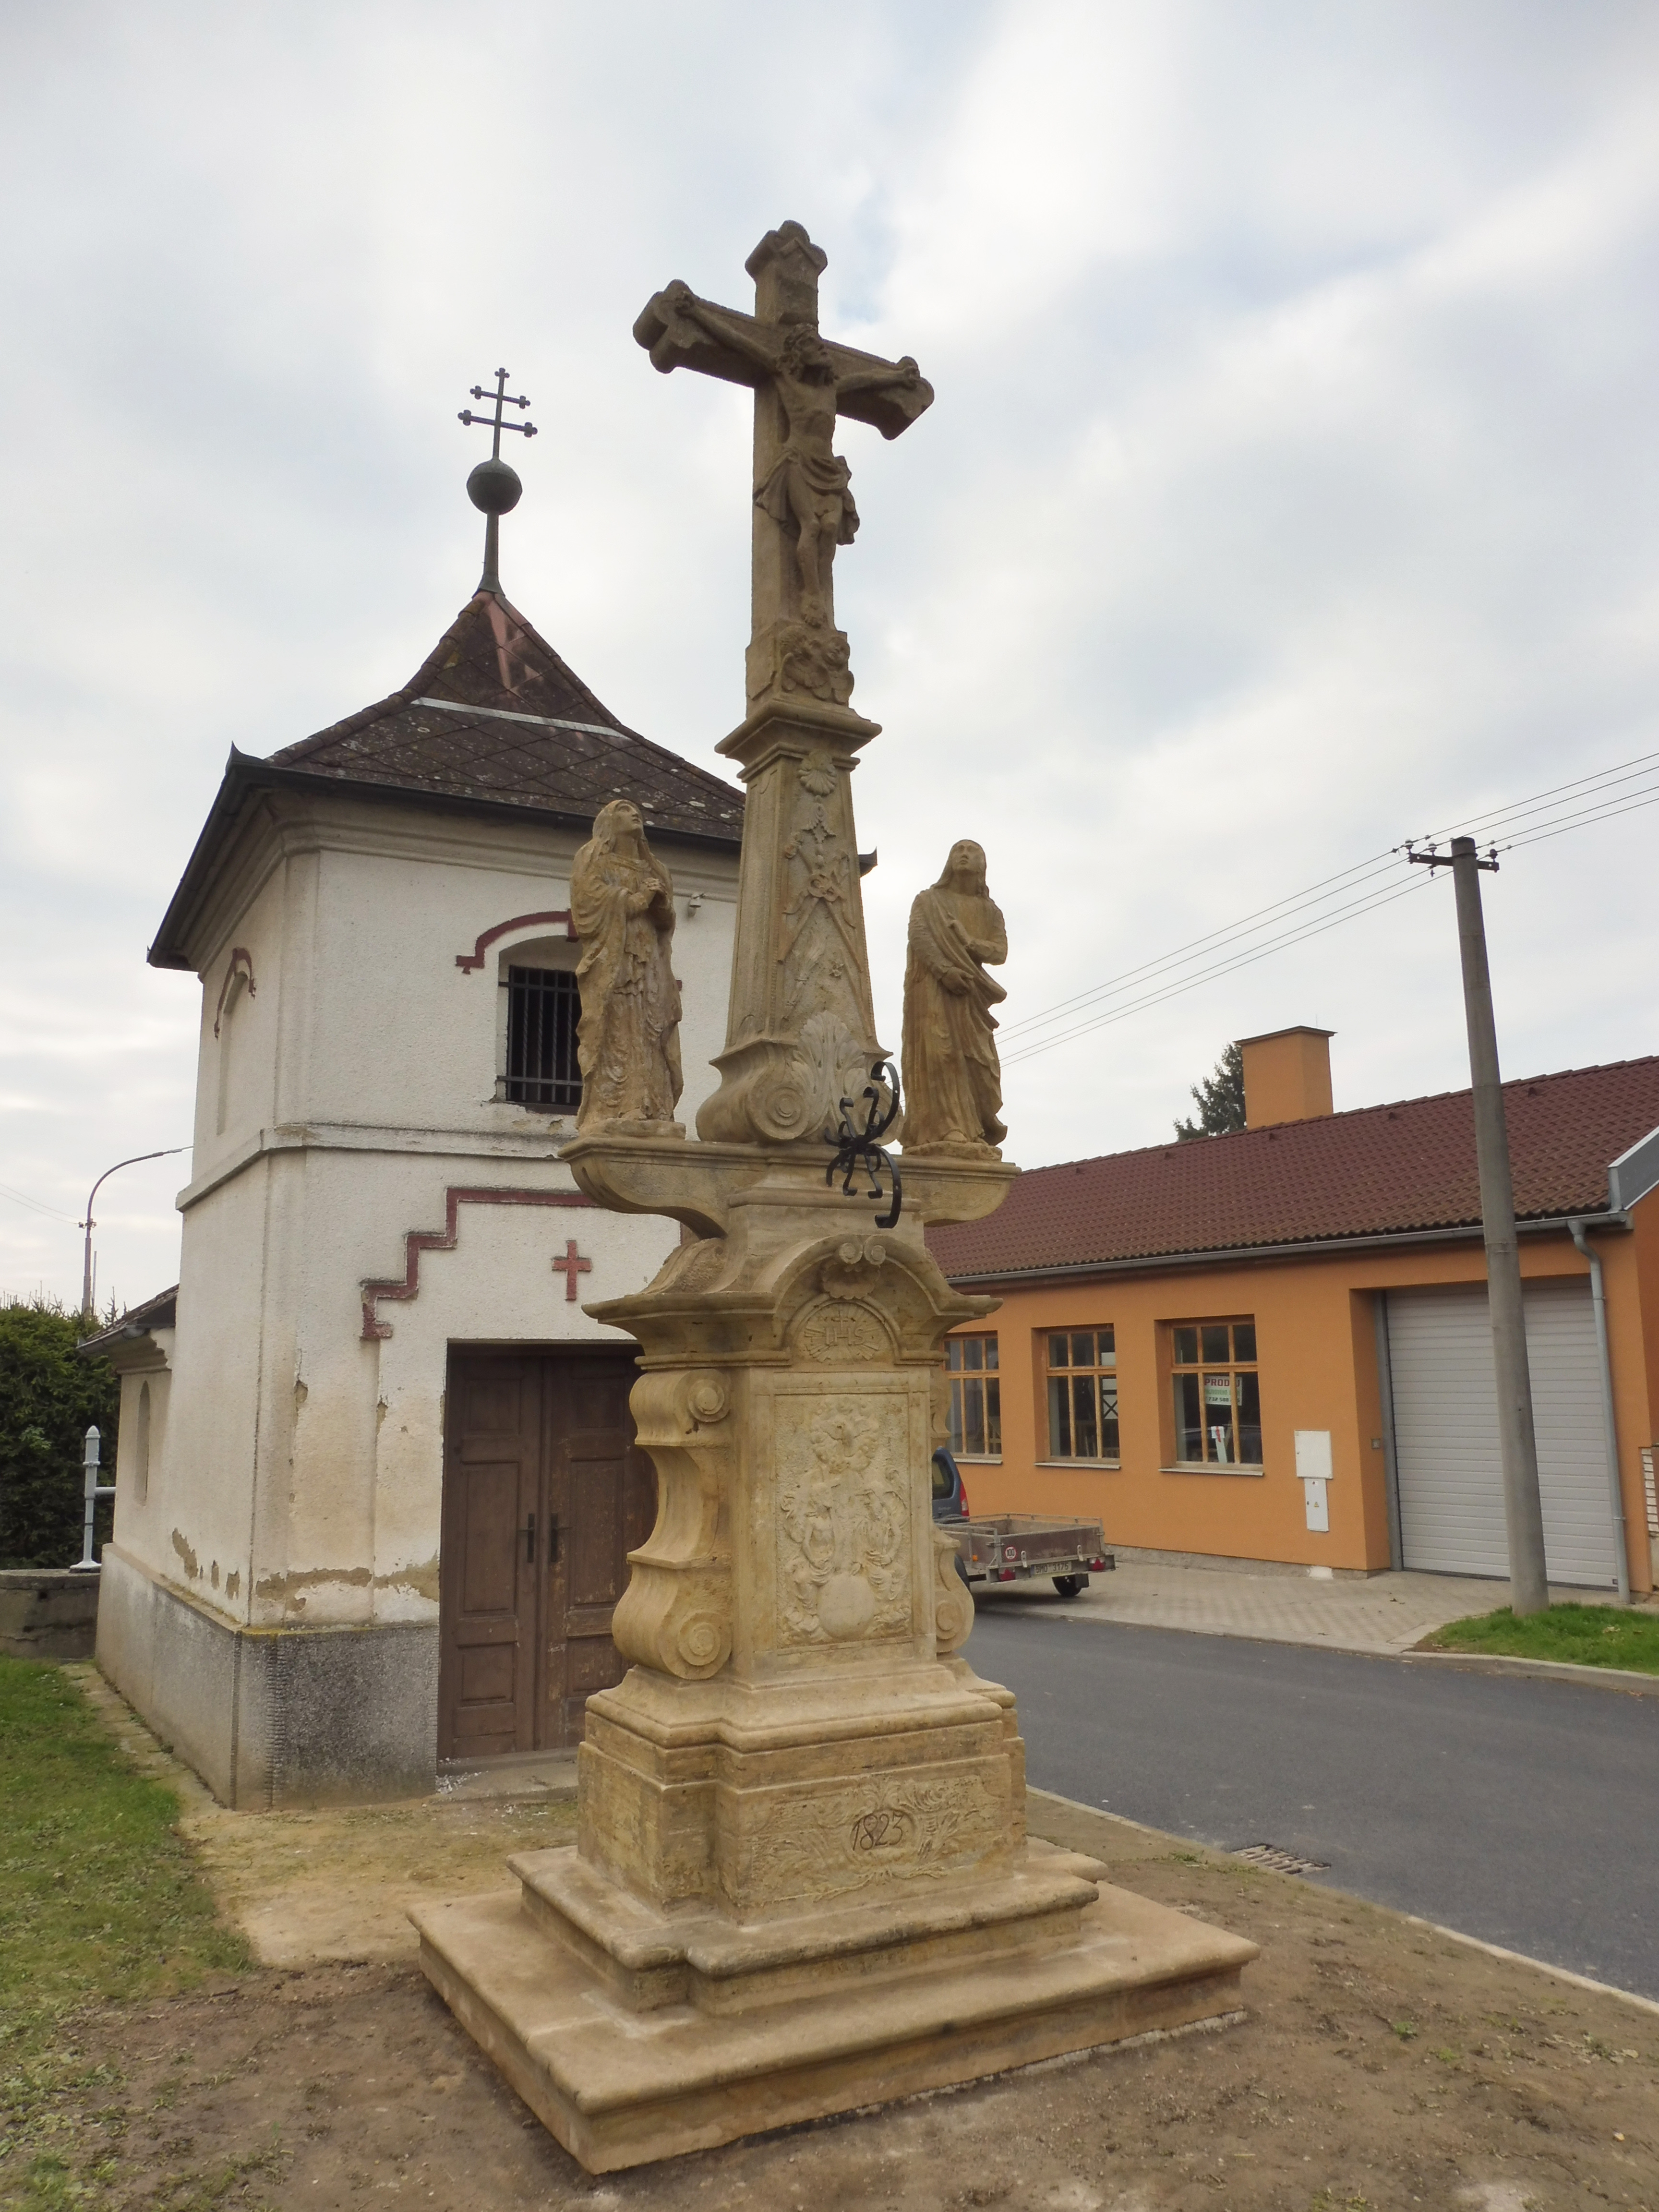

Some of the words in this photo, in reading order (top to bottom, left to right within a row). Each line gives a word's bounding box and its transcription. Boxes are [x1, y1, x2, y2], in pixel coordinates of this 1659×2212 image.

[825, 1326, 866, 1346] IHS
[1204, 1378, 1240, 1387] PRODJ
[1007, 1548, 1015, 1557] 100
[1053, 1563, 1069, 1572] 3175
[852, 1811, 905, 1851] 1823
